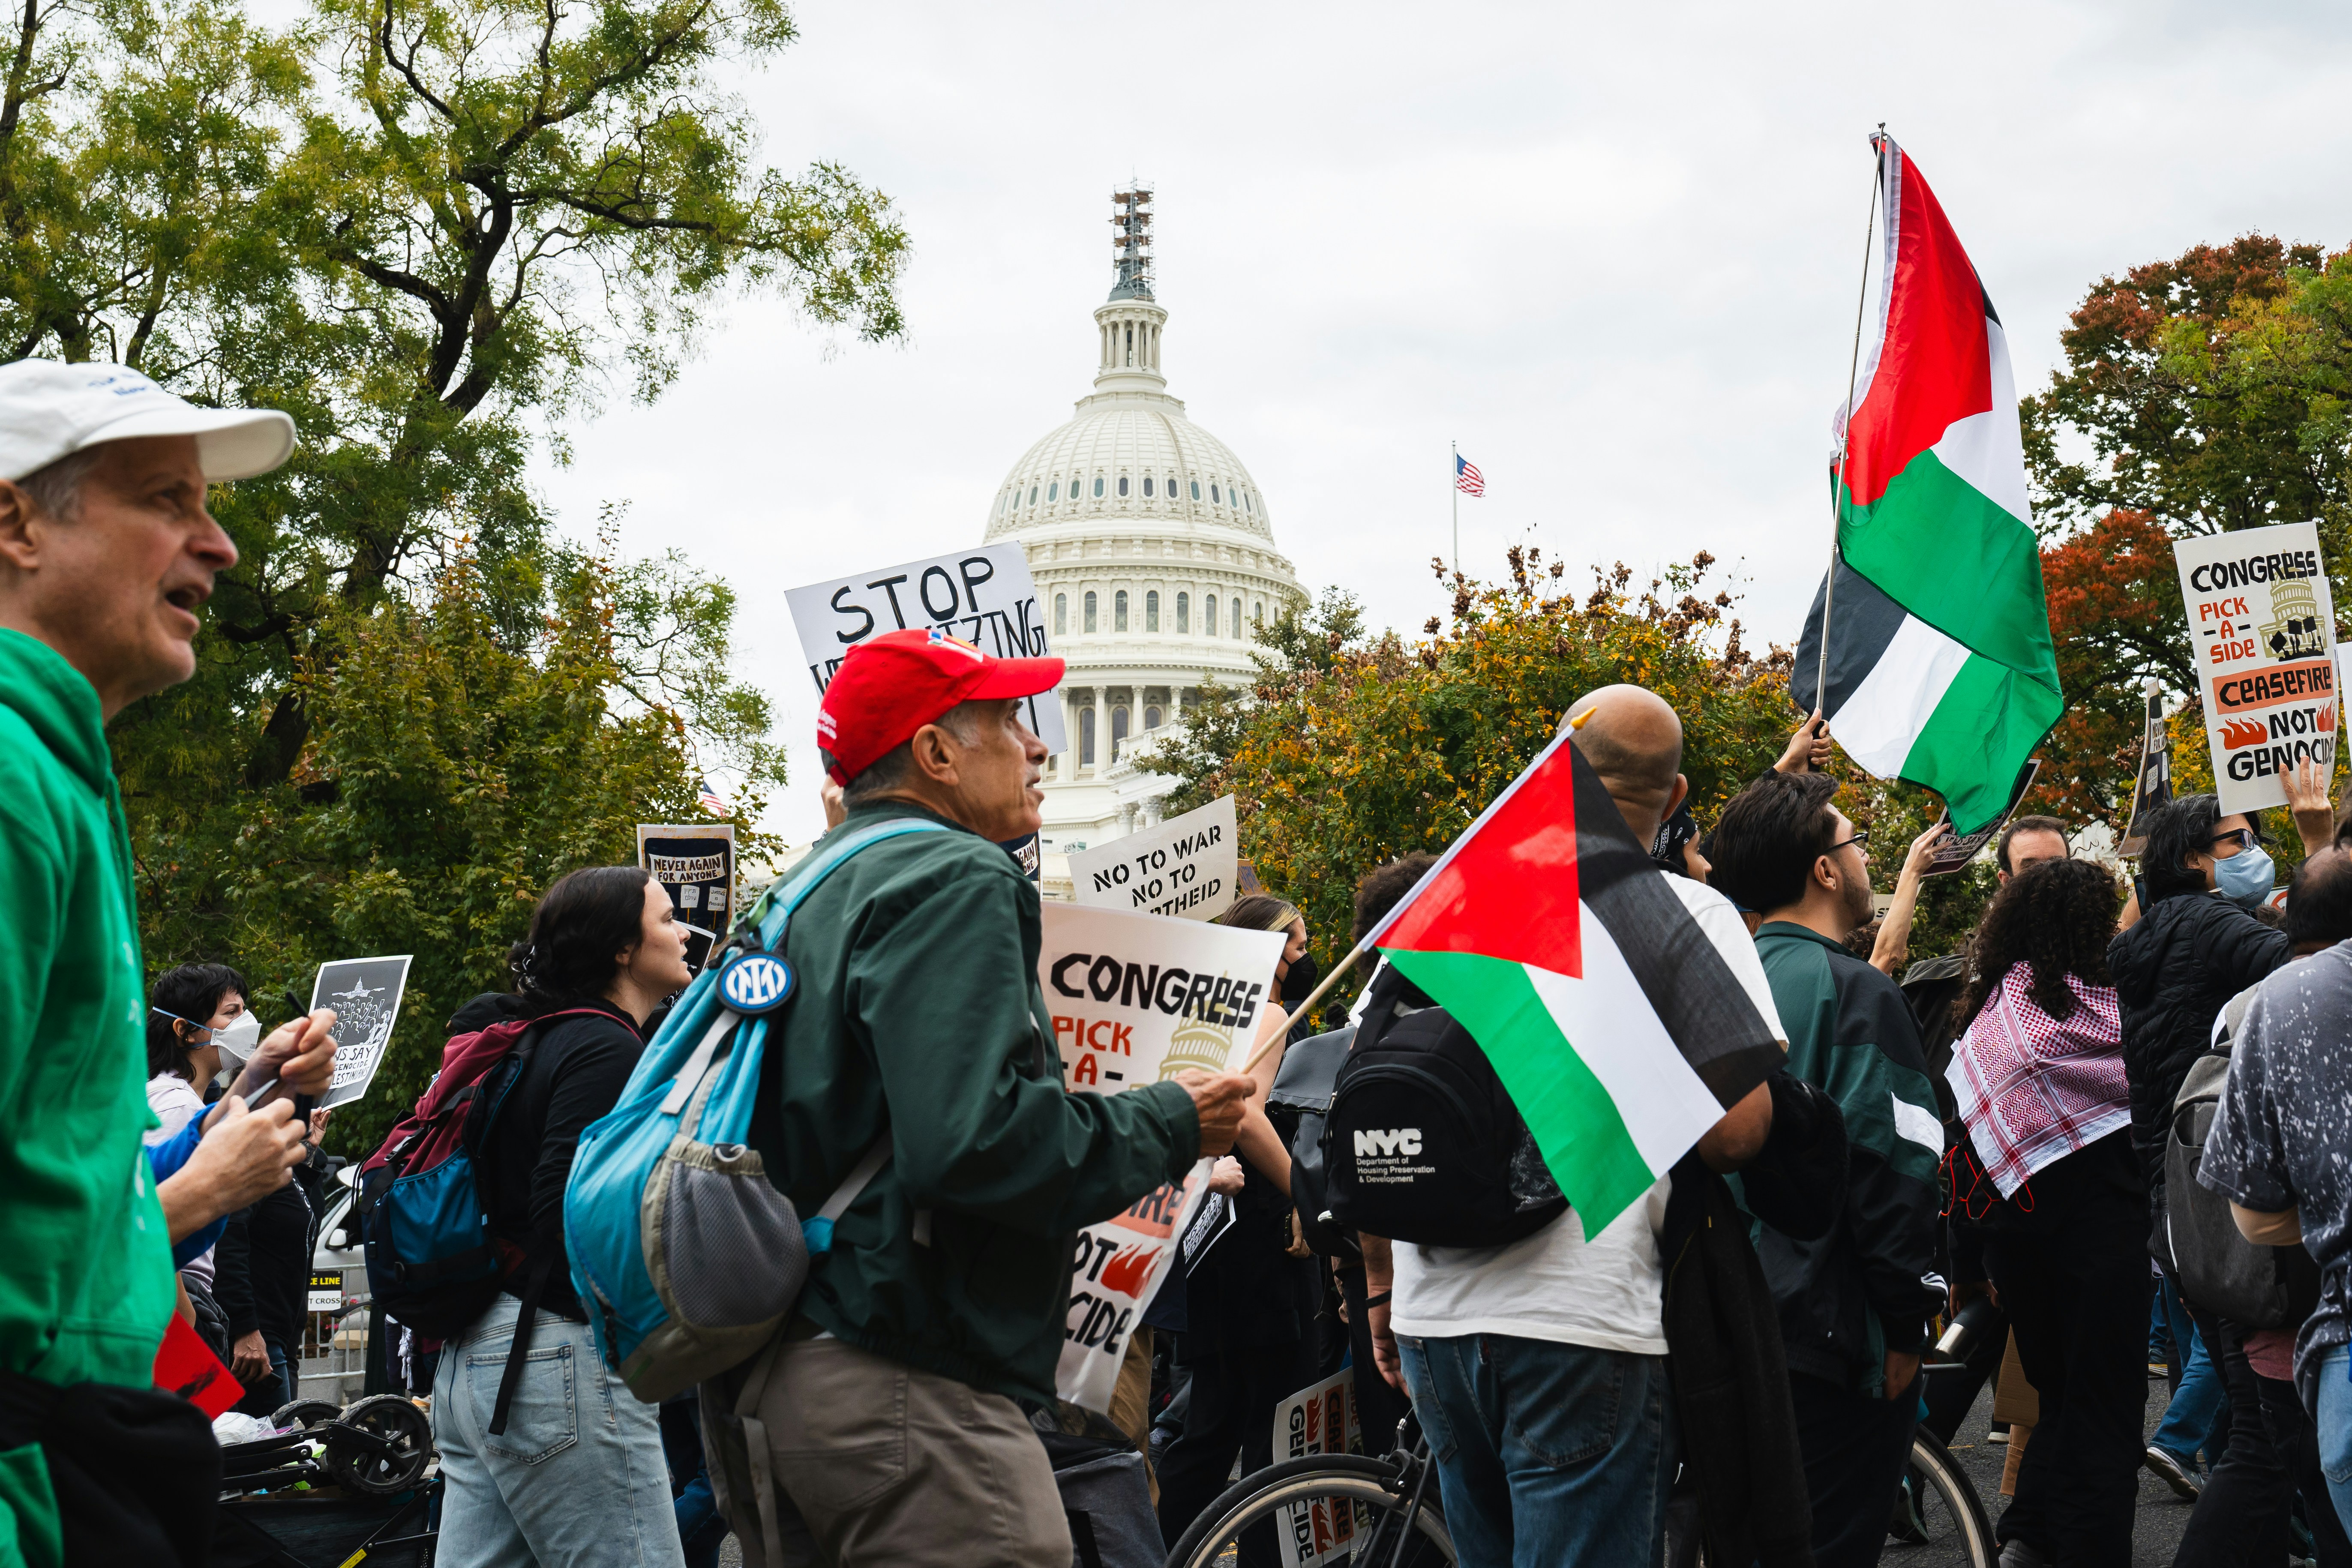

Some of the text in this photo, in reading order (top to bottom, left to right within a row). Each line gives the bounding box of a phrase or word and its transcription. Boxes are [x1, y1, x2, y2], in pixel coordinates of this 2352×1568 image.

[831, 557, 994, 644] STOP
[2199, 597, 2250, 622] PICK
[2268, 708, 2316, 740] NOT
[654, 857, 721, 872] NEVER AGAIN
[1093, 824, 1221, 892] NO TO WAR
[658, 869, 717, 882] FOR ANYONE
[1132, 863, 1196, 908] NO TO
[1150, 878, 1221, 916] THEID
[1052, 1016, 1134, 1057] PICK
[334, 1059, 369, 1071] GENOCIDE
[349, 1046, 374, 1061] SAY
[332, 1066, 370, 1085] LESTINIANS
[1354, 1128, 1422, 1157] NYC
[1356, 1157, 1399, 1166] Department
[1357, 1167, 1388, 1175] Housing
[1366, 1175, 1413, 1184] Development
[1074, 1231, 1119, 1282] OT
